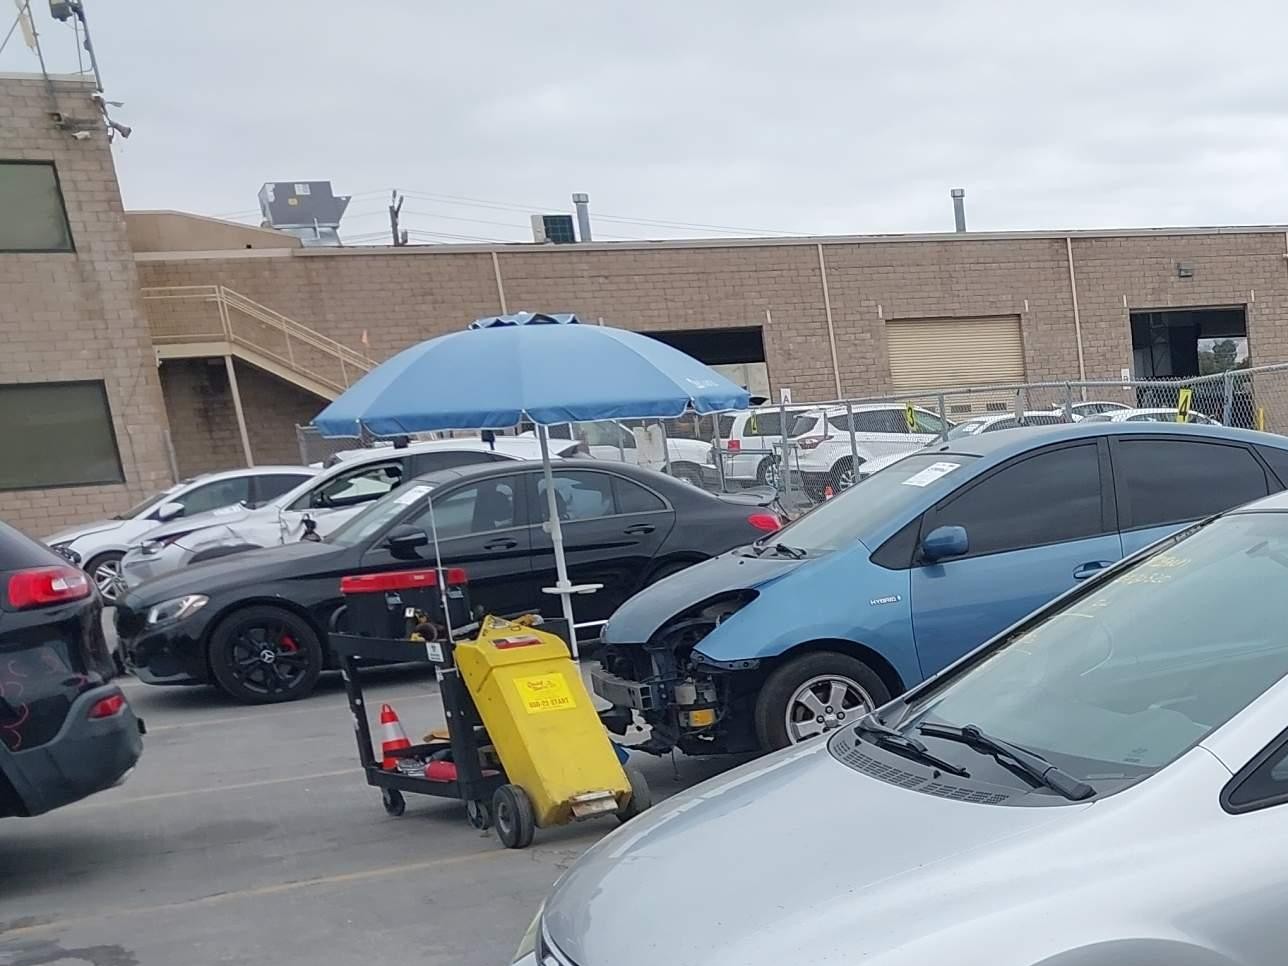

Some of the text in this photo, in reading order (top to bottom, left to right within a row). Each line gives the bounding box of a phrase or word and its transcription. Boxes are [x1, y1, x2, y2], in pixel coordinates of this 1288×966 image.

[783, 393, 791, 404] A
[1179, 393, 1190, 421] 4
[907, 406, 915, 427] 3
[870, 596, 897, 605] HYBRID
